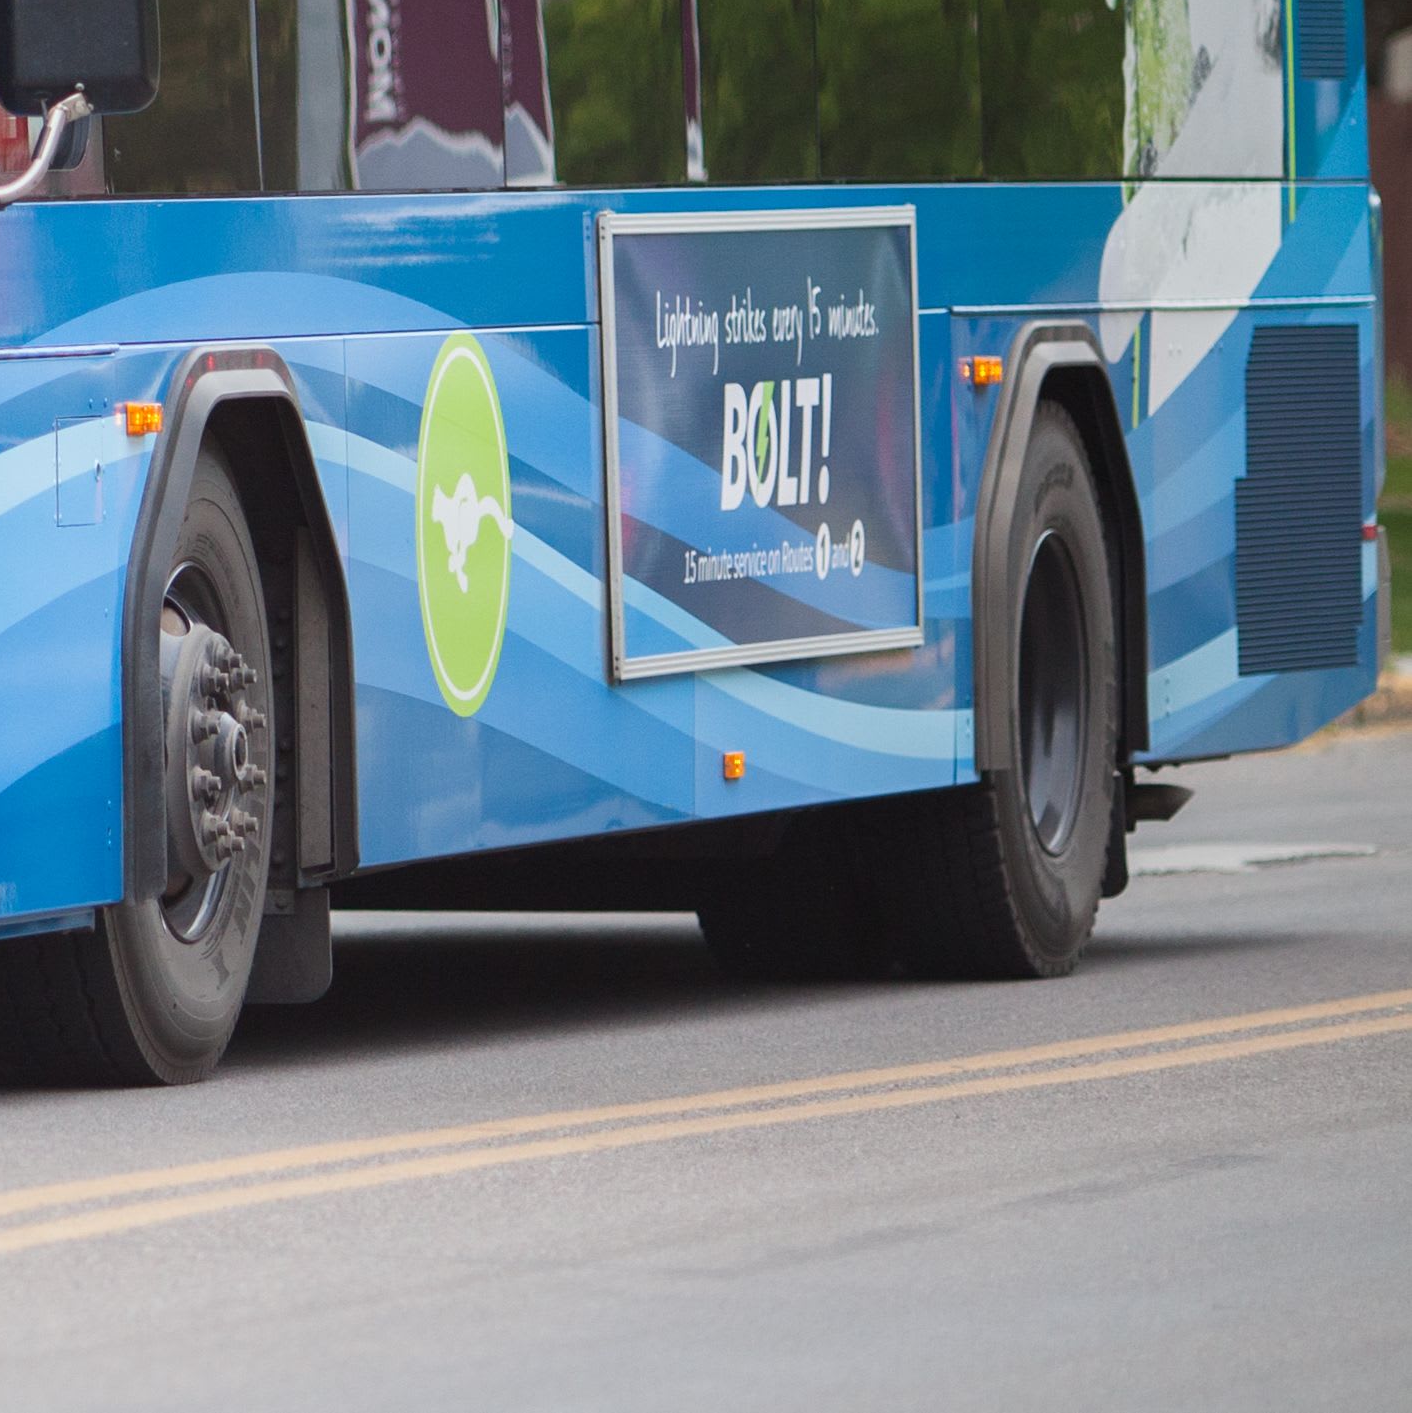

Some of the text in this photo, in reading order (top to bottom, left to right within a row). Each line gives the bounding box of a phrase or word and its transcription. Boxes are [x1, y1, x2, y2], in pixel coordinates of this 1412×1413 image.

[656, 276, 879, 378] Lightning strikes every 15 minutes.
[721, 373, 833, 511] BOLT!
[684, 549, 697, 584] 15
[698, 546, 732, 582] minute
[734, 542, 766, 579] service
[768, 547, 780, 575] on
[782, 540, 814, 573] Routes
[832, 532, 850, 569] and
